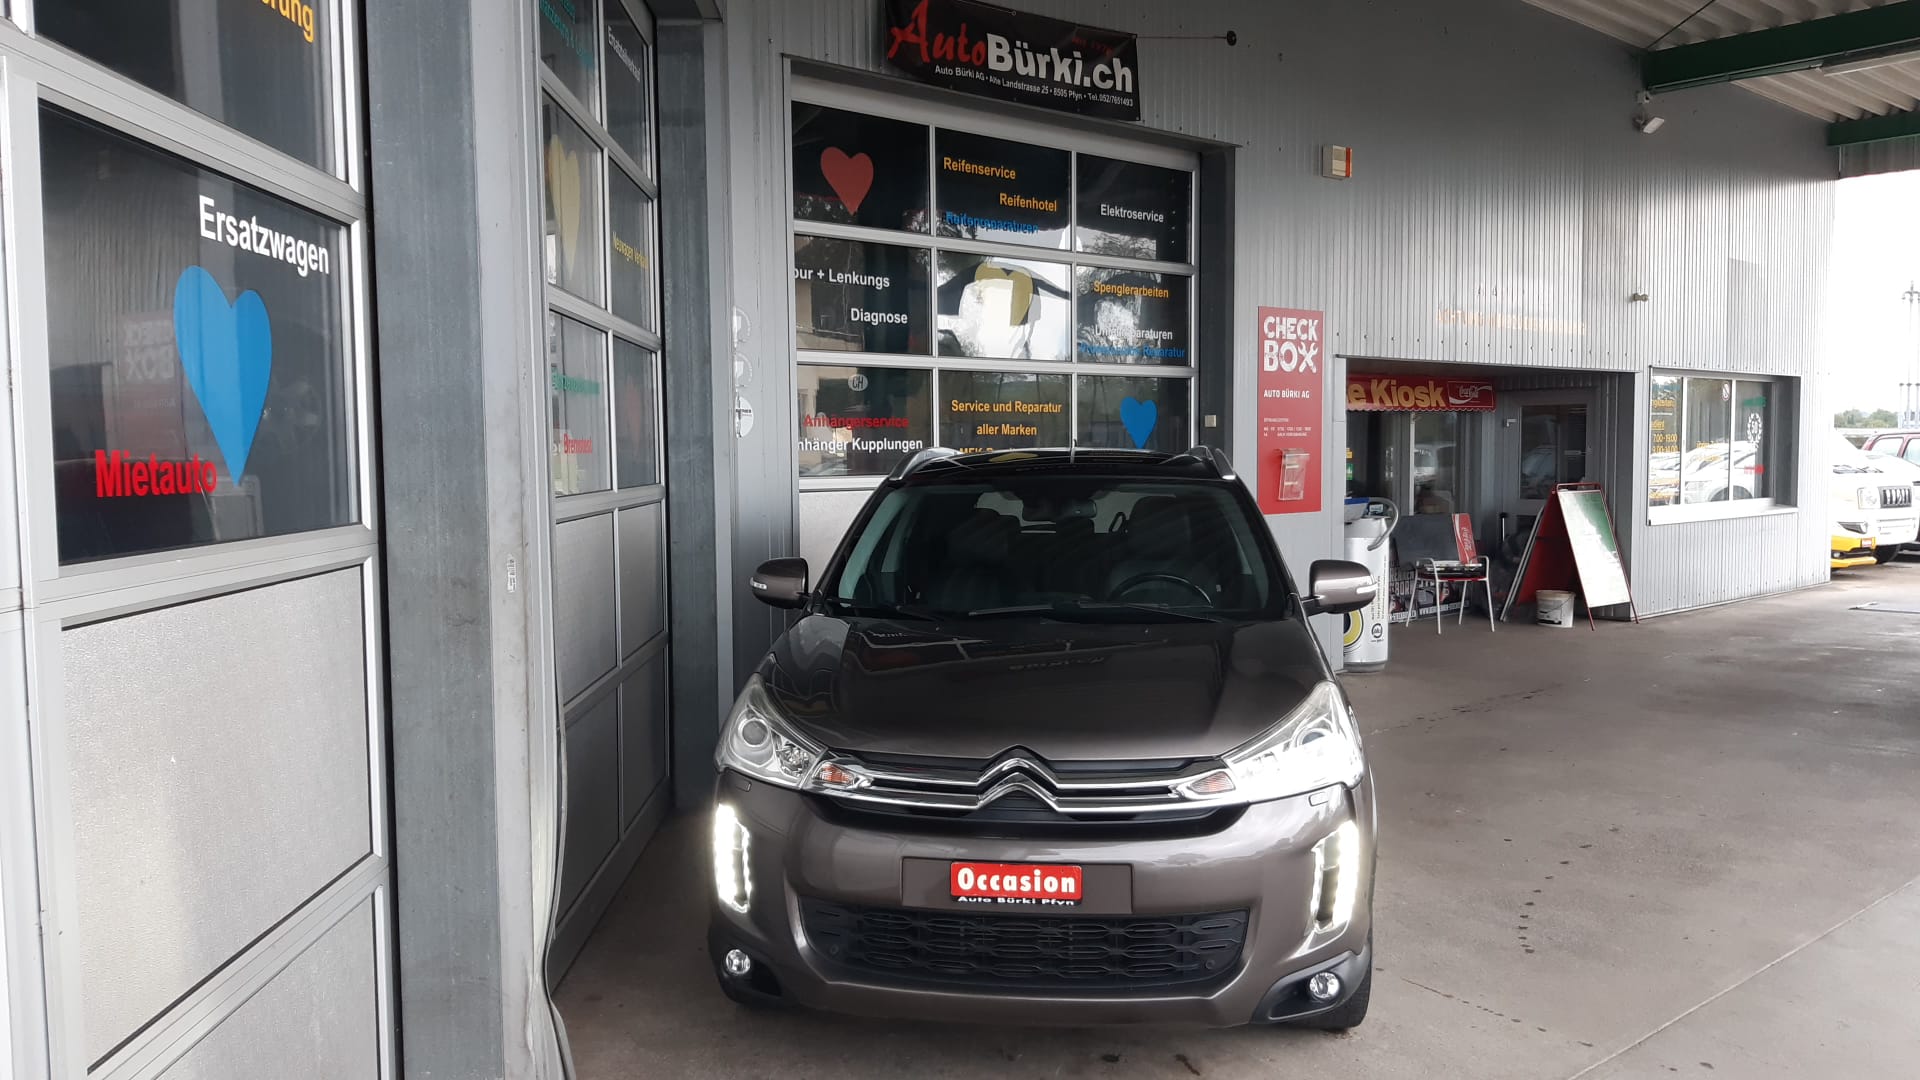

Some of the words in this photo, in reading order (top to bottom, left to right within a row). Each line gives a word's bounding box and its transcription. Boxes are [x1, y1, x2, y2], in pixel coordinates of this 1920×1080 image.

[935, 65, 954, 76] Auto
[955, 67, 975, 79] Bürki
[975, 72, 985, 81] AG
[1002, 78, 1041, 93] Landstrasse
[1041, 85, 1049, 94] 25
[1068, 90, 1083, 102] Pfyn
[943, 156, 1016, 180] Reifenservice
[999, 192, 1057, 212] Reifenhotel
[1100, 203, 1164, 223] Elektroservice
[198, 194, 330, 277] Ersatzwagen
[829, 269, 891, 290] Lenkungs
[1093, 280, 1169, 299] Spenglerarbeiten
[850, 308, 908, 326] Diagnose
[1263, 316, 1319, 341] CHECK
[1263, 340, 1319, 373] BOX
[1264, 389, 1280, 398] AUTO
[1281, 388, 1300, 399] BÜRKI
[1301, 390, 1310, 399] AG
[1371, 379, 1446, 408] Kiosk
[951, 399, 990, 412] Service
[993, 400, 1012, 412] und
[1014, 400, 1062, 415] Reparatur
[803, 413, 909, 430] Anhängerservice
[976, 424, 999, 435] aller
[1001, 423, 1037, 436] Marken
[852, 437, 923, 453] Kupplungen
[95, 449, 217, 498] Mietauto
[957, 867, 1075, 893] Occasion
[958, 896, 992, 904] Auto
[997, 896, 1036, 905] Bürki
